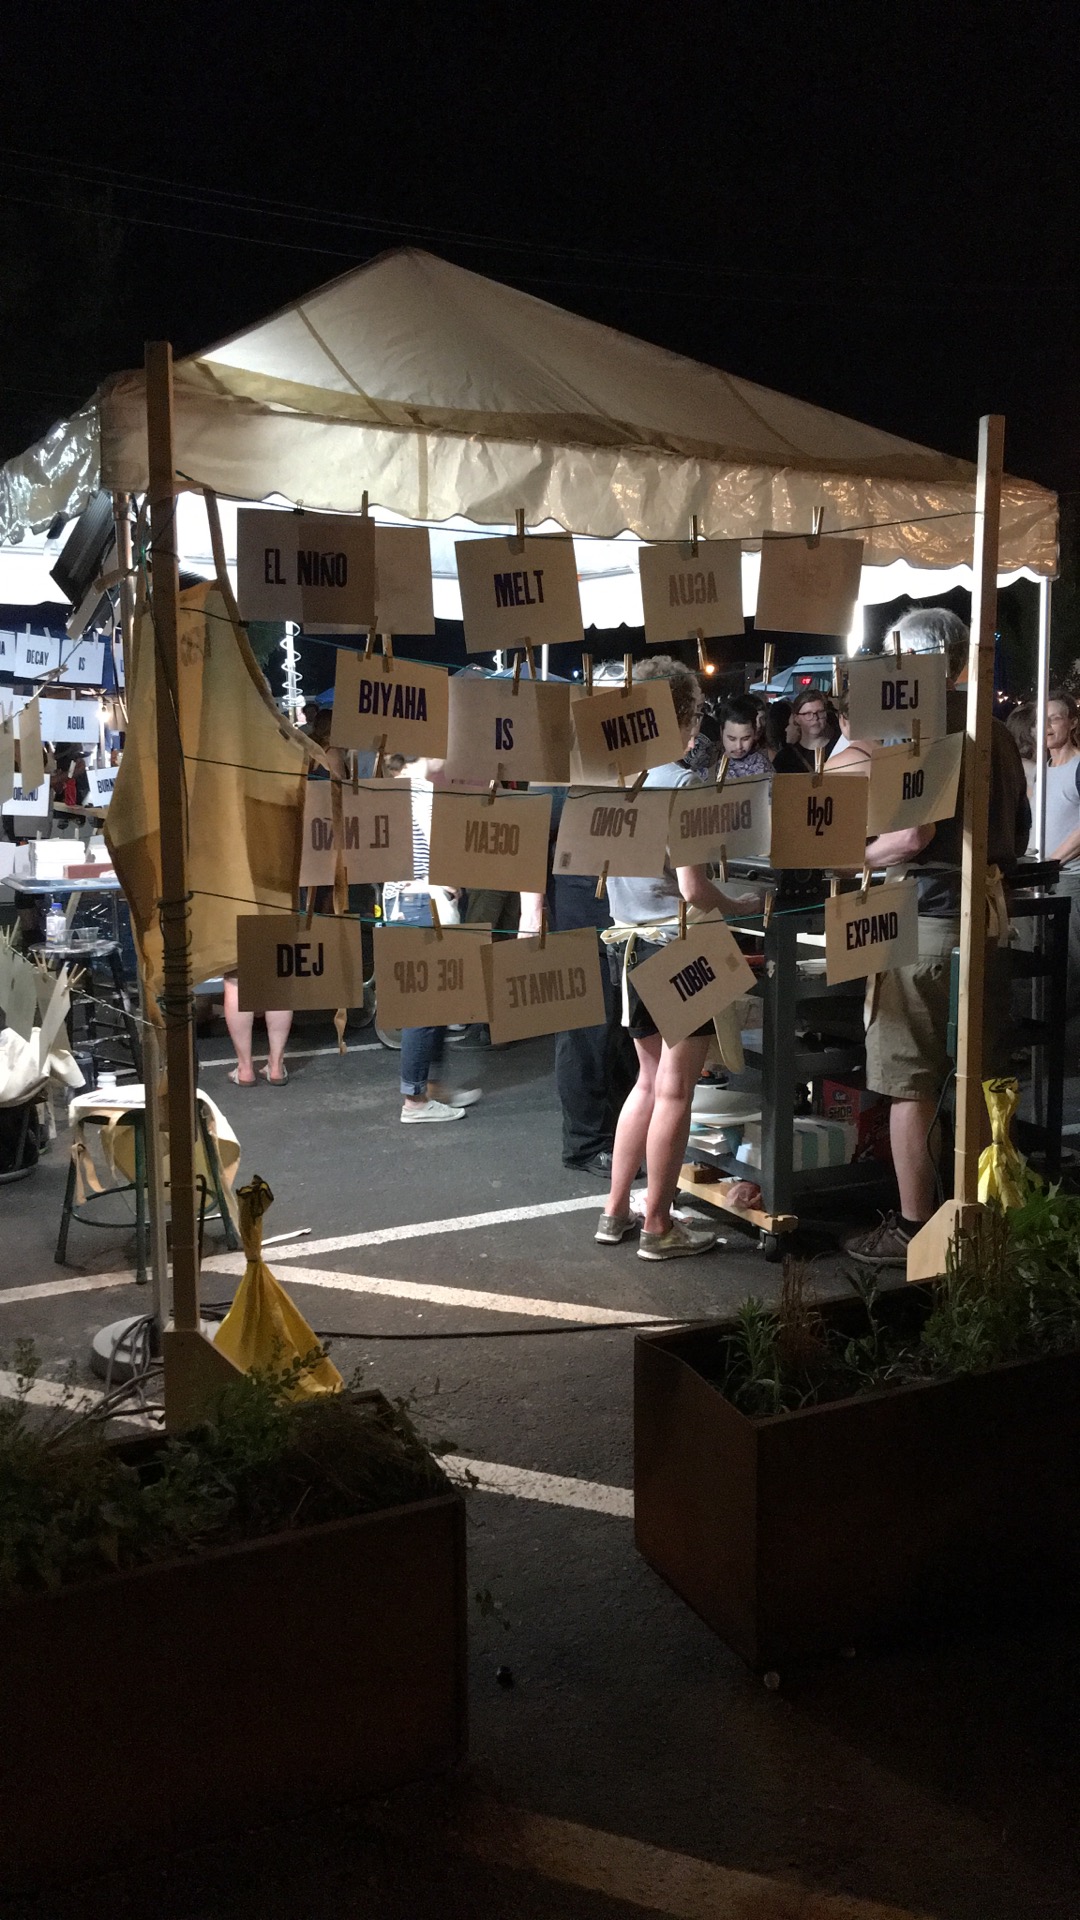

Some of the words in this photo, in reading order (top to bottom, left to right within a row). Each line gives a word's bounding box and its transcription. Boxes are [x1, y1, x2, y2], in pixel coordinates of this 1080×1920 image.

[264, 548, 286, 585] EL
[297, 550, 348, 588] NIÑO
[493, 569, 545, 608] MELT
[26, 649, 50, 666] DECAY
[78, 656, 86, 671] IS
[358, 679, 428, 722] BIYAHA
[881, 680, 920, 711] DEJ
[67, 715, 85, 730] AGUA
[495, 717, 514, 751] IS
[600, 707, 660, 752] WATER
[845, 911, 899, 951] EXPAND
[276, 942, 325, 978] DEJ
[668, 955, 718, 1003] TUBIG
